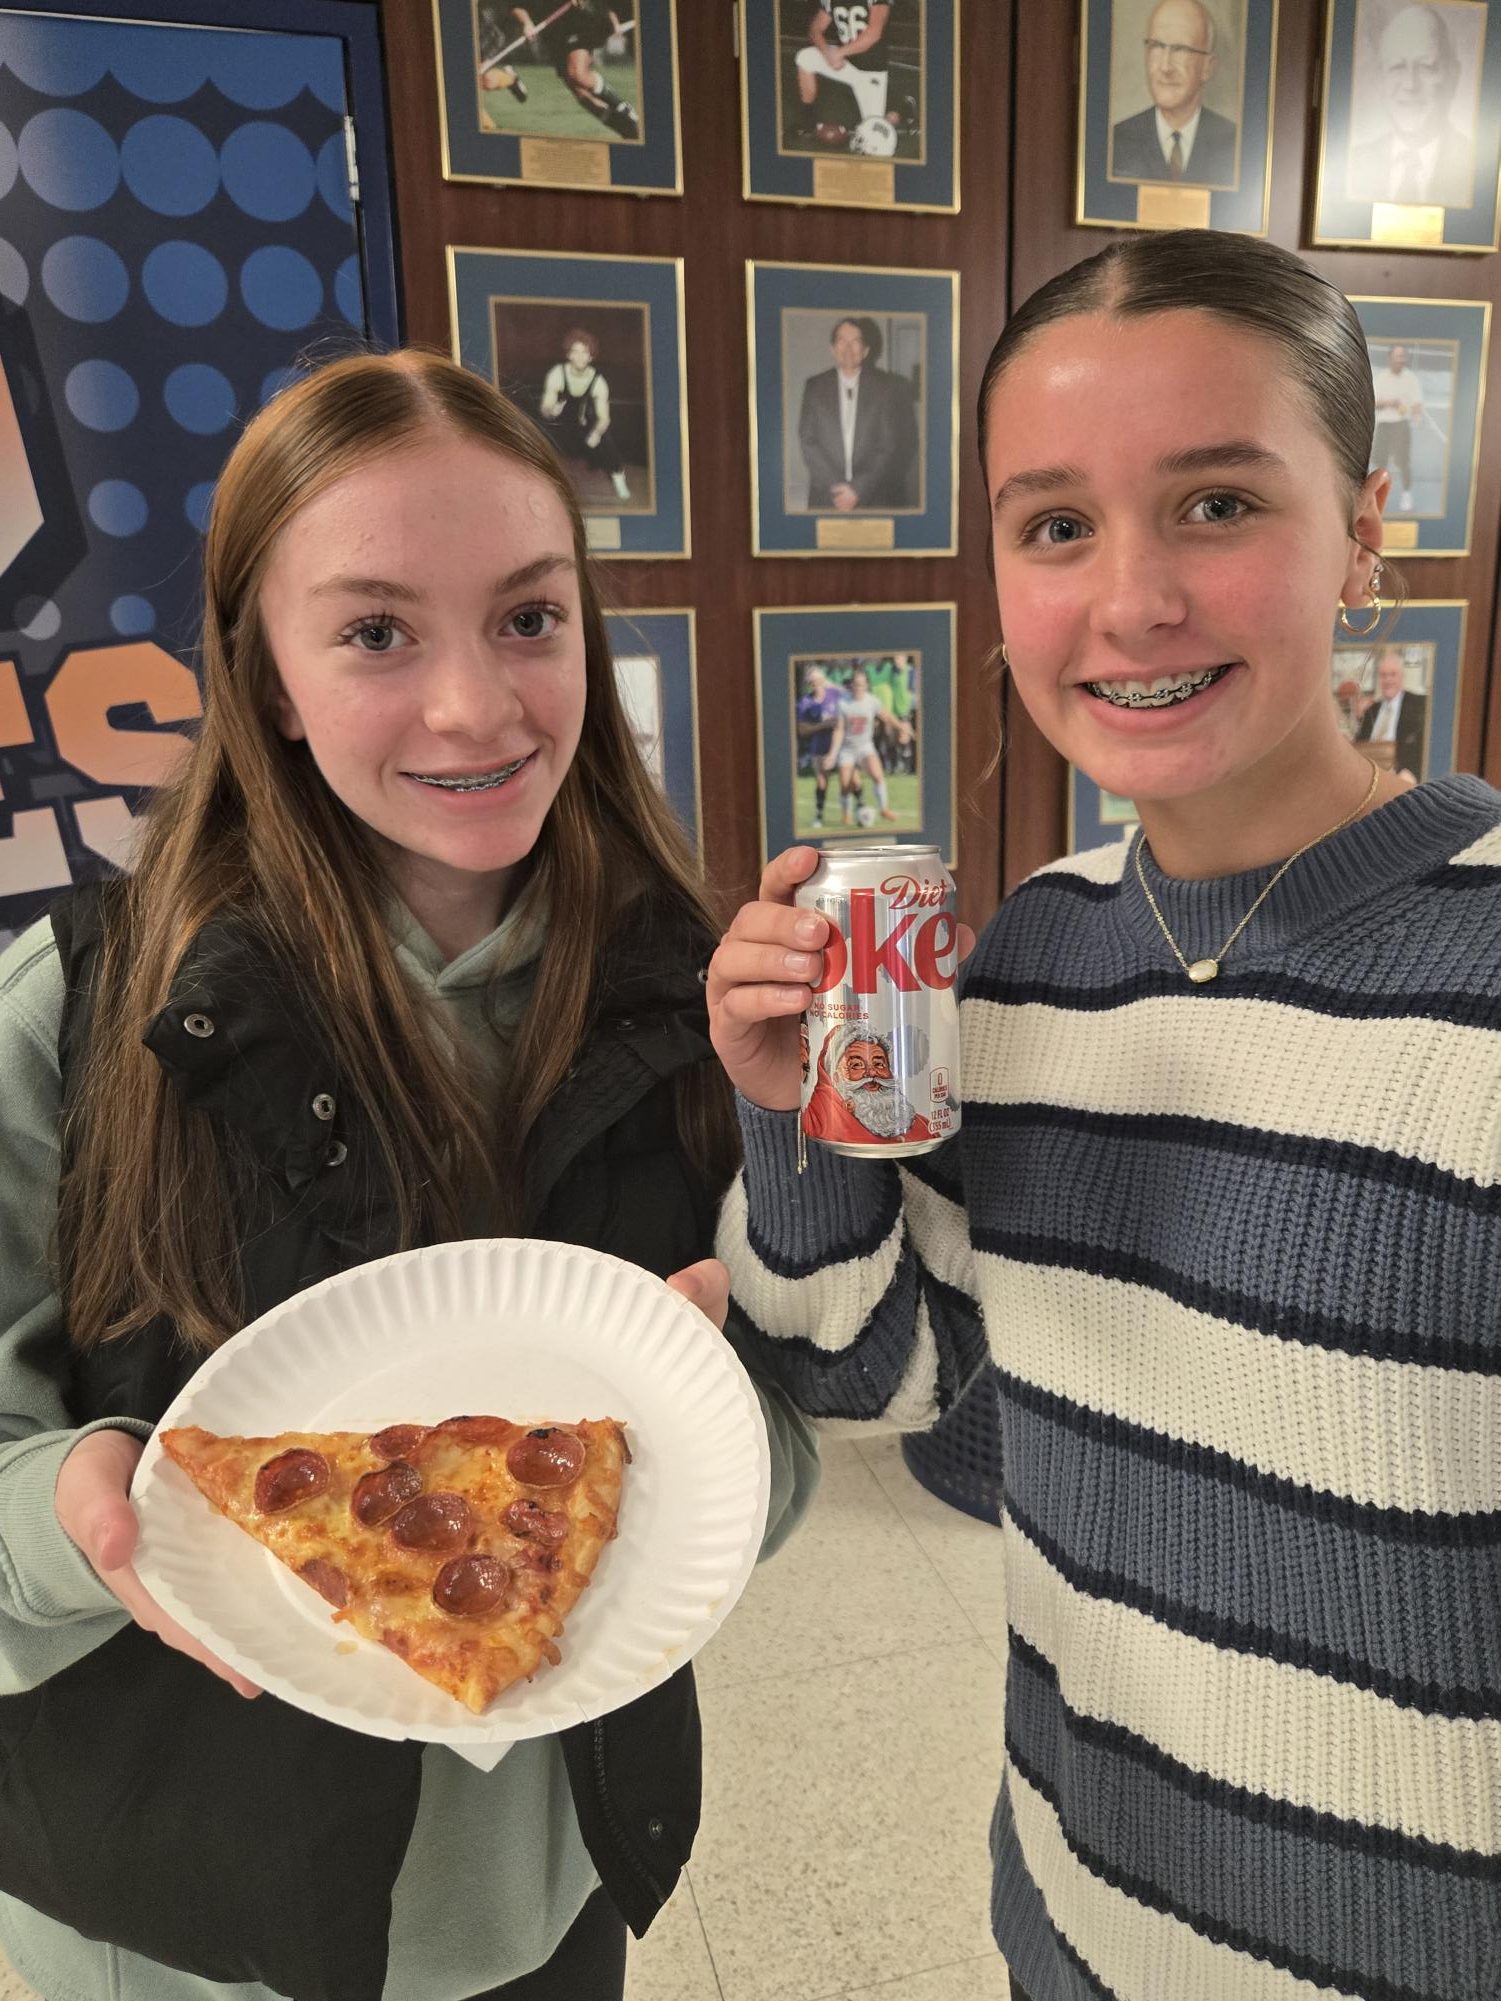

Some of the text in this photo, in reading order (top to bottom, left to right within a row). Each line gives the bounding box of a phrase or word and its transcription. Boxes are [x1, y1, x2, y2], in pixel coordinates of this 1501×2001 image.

[880, 875, 947, 909] Diet
[814, 1002, 861, 1012] NO SUGAR
[820, 1011, 870, 1020] CALORIES
